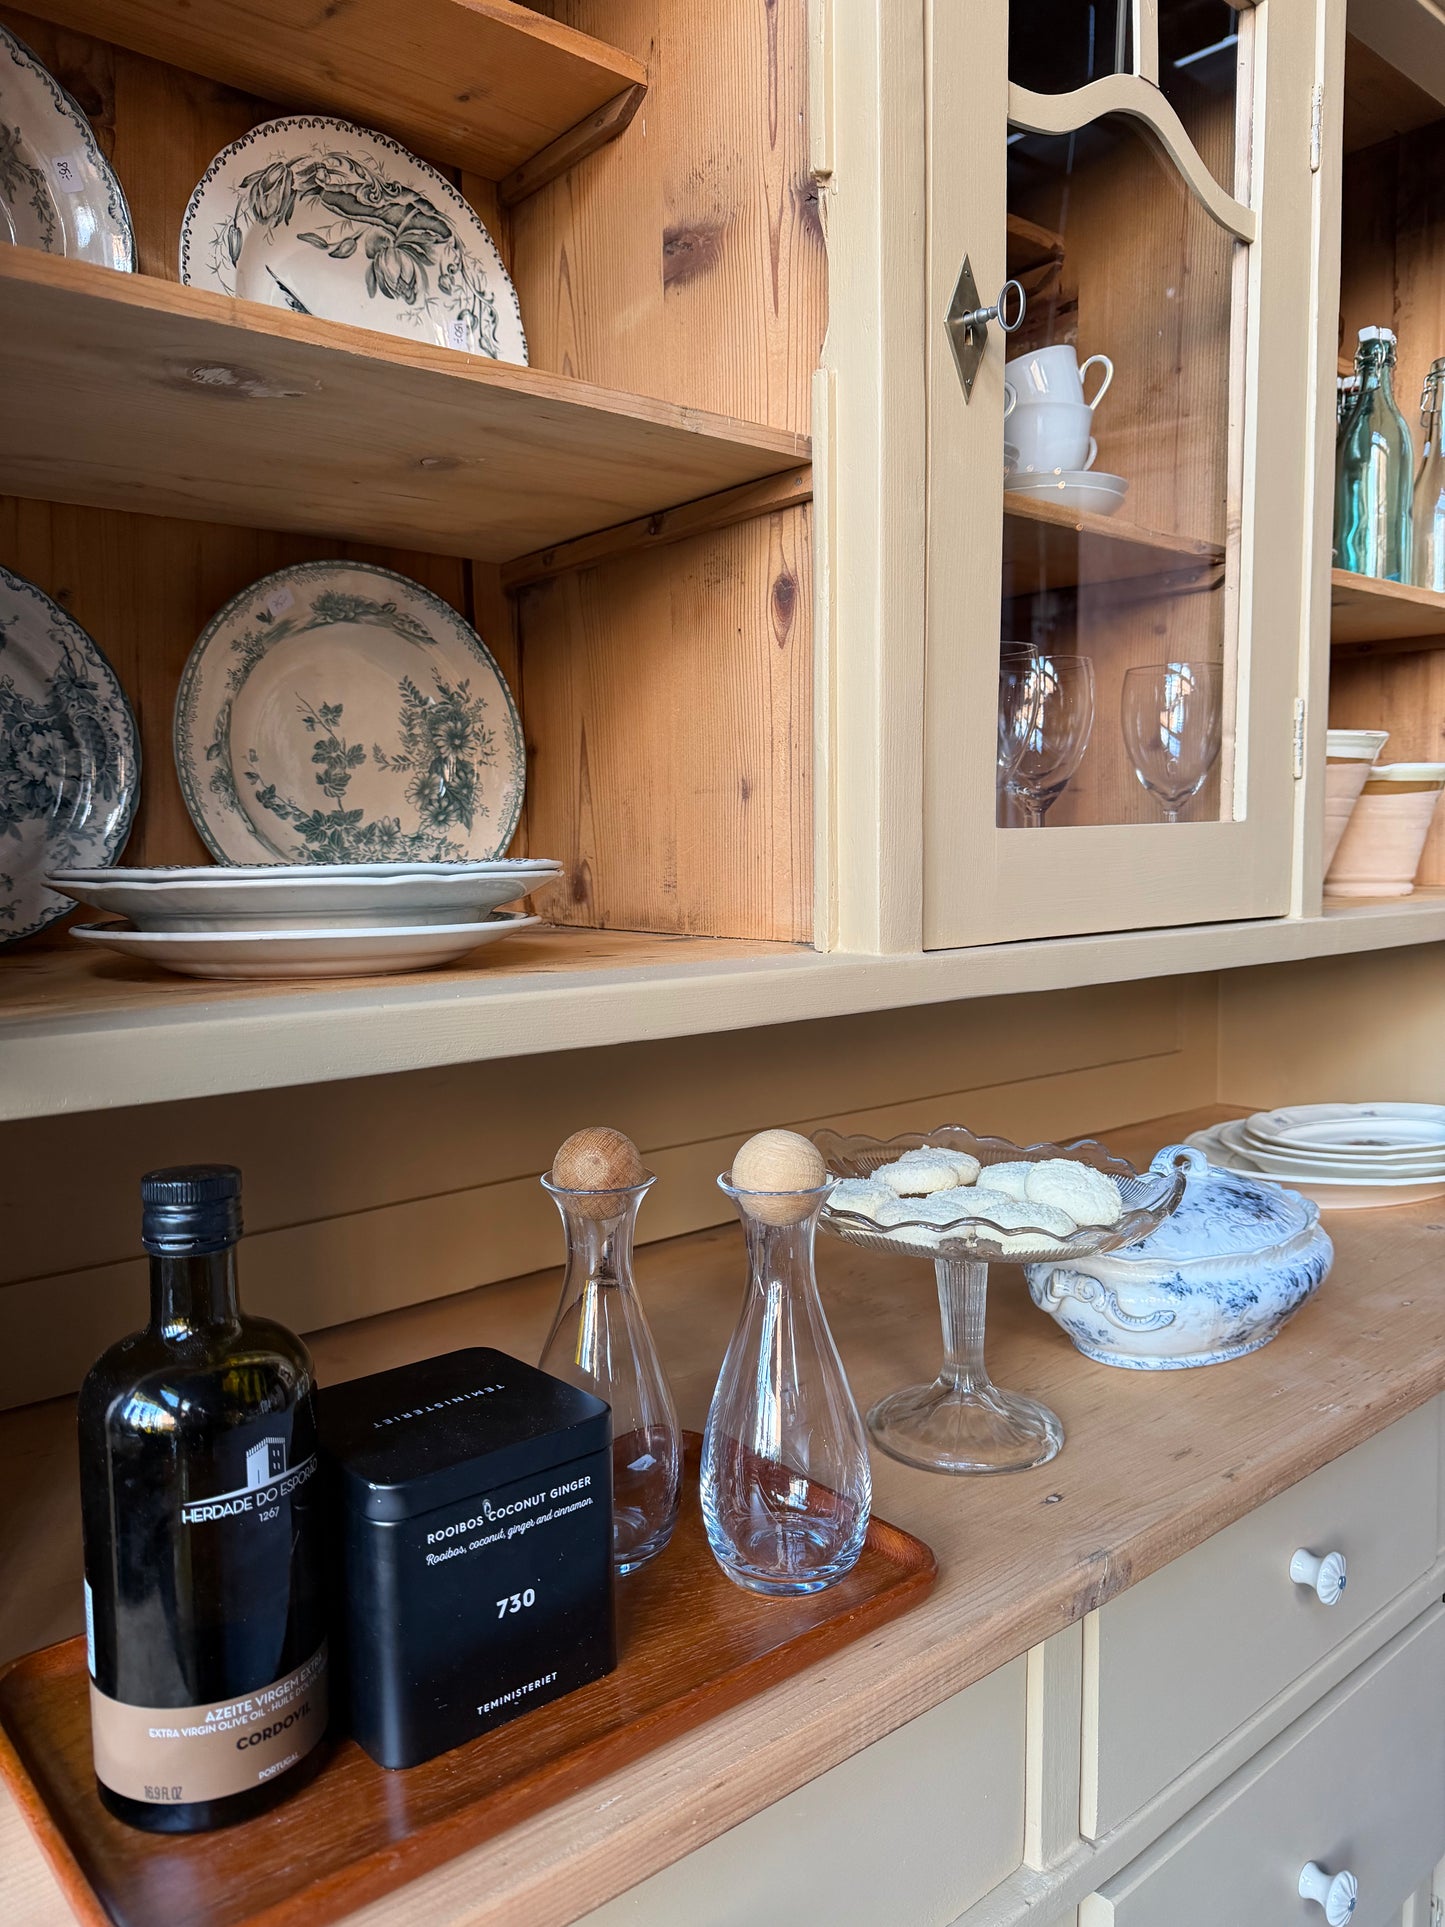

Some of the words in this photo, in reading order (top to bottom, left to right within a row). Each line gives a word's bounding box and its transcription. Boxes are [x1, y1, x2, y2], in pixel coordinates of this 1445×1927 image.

[373, 1384, 505, 1429] TEMINISTERIET
[181, 1495, 254, 1525] HERDADE
[256, 1487, 279, 1507] DO
[258, 1506, 280, 1522] 1267
[427, 1515, 484, 1545] ROOIBOS
[488, 1492, 546, 1522] COCONUT
[549, 1475, 592, 1499] GINGER
[425, 1546, 467, 1566] Rooibos,
[468, 1529, 506, 1550] coconut,
[507, 1518, 535, 1540] ginger
[536, 1508, 553, 1525] and
[553, 1496, 593, 1519] cinnamon.
[496, 1588, 536, 1619] 730
[148, 1727, 180, 1739] EXTRA
[181, 1723, 216, 1737] VIRGIN
[218, 1713, 248, 1732] OLIVE
[250, 1708, 266, 1721] OIL
[271, 1691, 295, 1713] HUILE
[204, 1700, 252, 1723] AZEITE
[255, 1676, 299, 1707] VIRGEM
[476, 1671, 558, 1715] TEMINISTERIET
[236, 1702, 312, 1750] CORDOVIL
[258, 1752, 300, 1780] PORTUGAL
[171, 1785, 182, 1800] OZ
